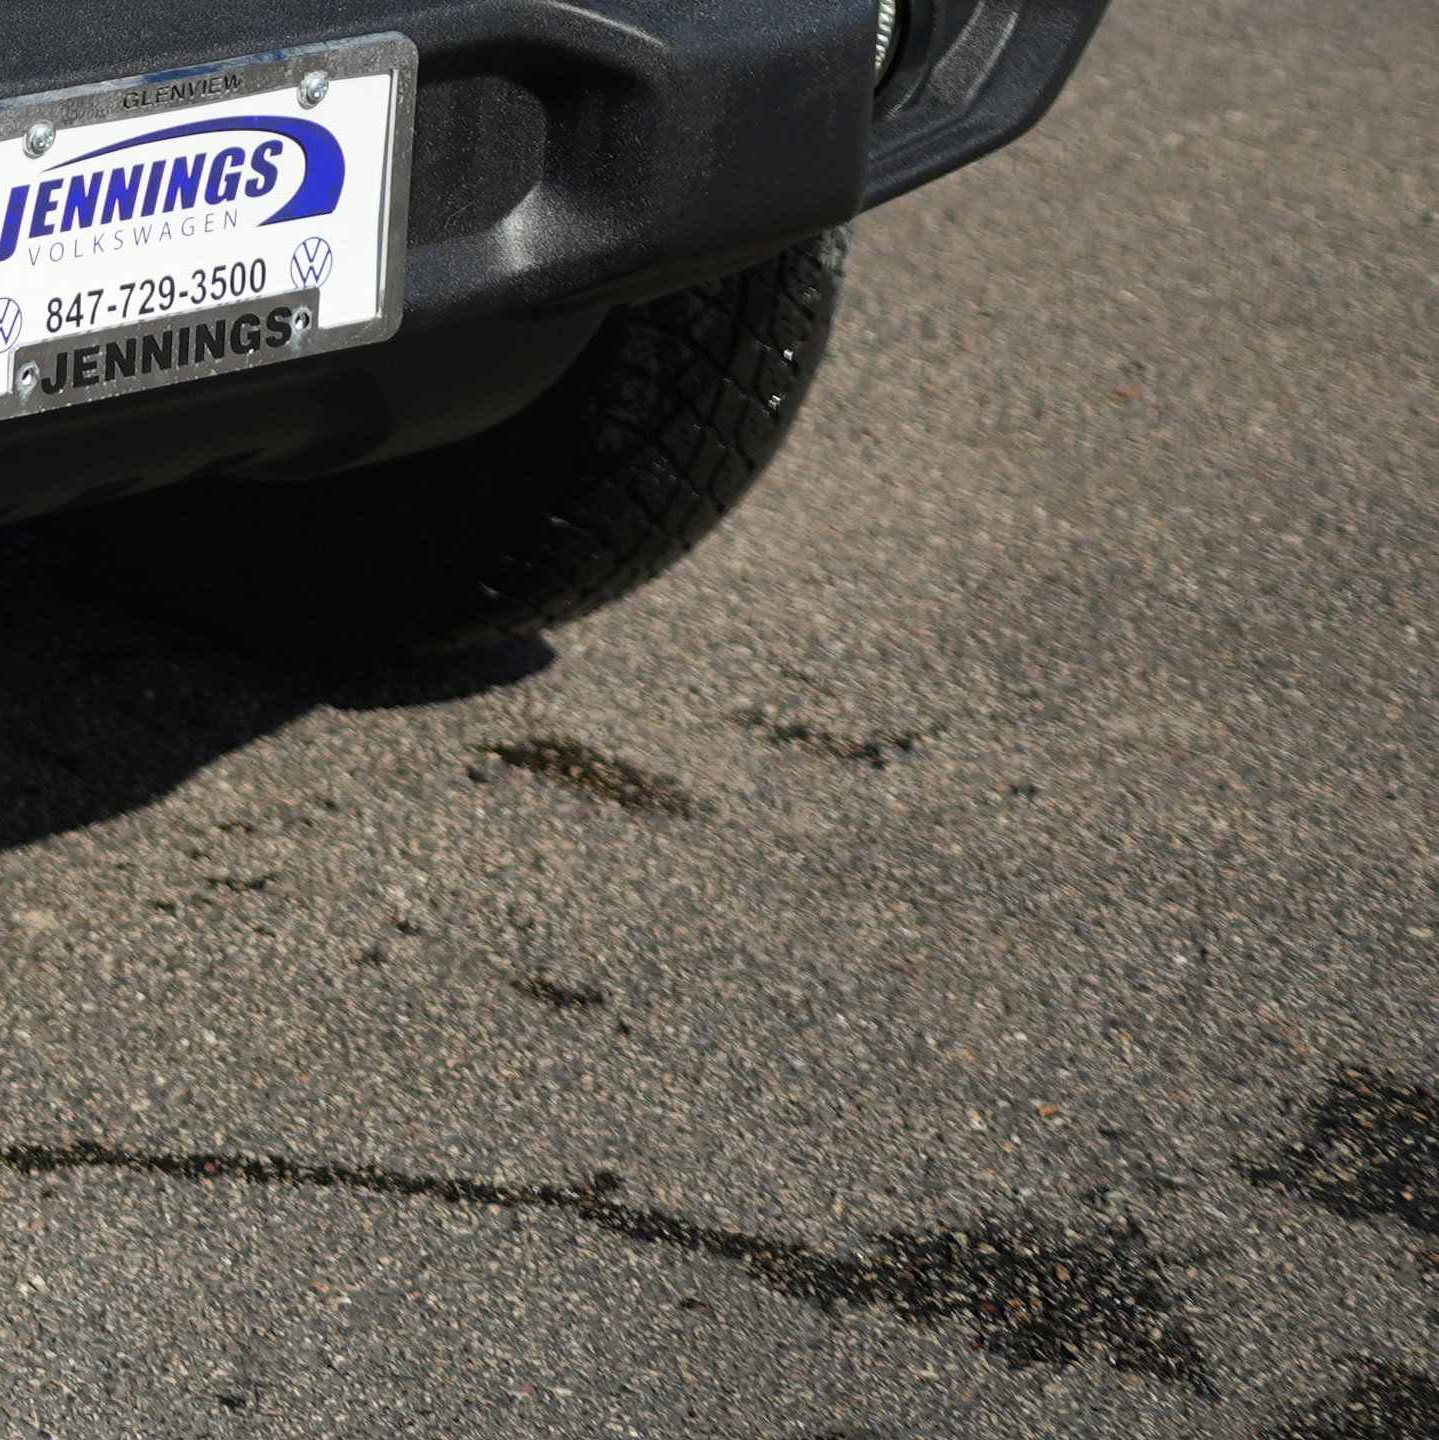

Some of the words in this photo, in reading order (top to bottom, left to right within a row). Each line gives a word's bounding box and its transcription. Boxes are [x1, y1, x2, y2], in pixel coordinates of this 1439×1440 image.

[122, 73, 244, 110] GLENVIEW
[28, 208, 238, 266] VOLKSWAGEN
[45, 258, 267, 333] 847-729-3500
[40, 306, 294, 395] JENNINGS
